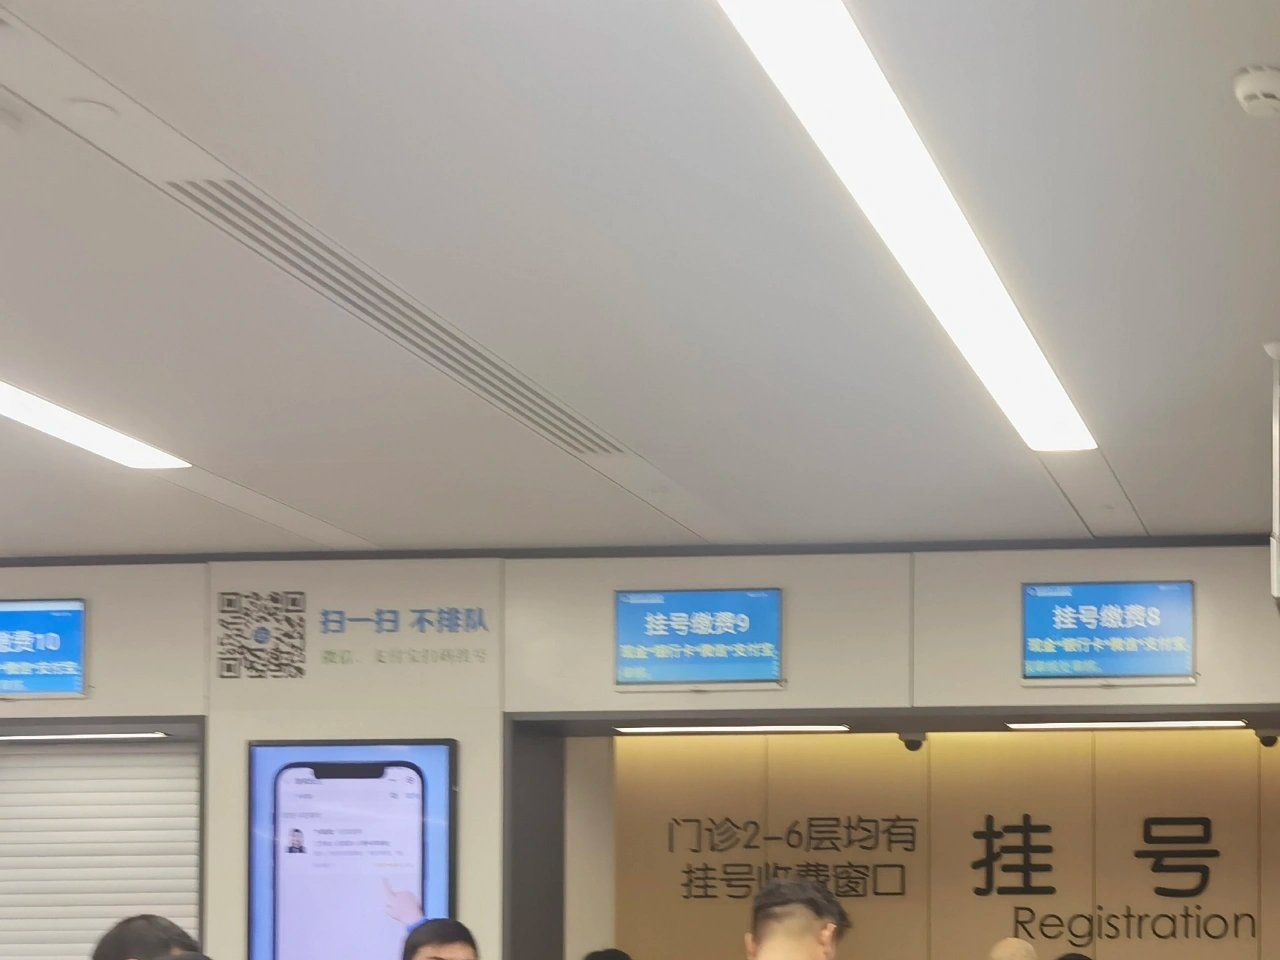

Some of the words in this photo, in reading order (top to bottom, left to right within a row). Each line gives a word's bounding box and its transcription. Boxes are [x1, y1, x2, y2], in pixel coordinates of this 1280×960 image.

[320, 609, 400, 634] 扫一扫
[409, 606, 490, 633] 不排队
[643, 611, 750, 636] 挂号缴费9
[1052, 604, 1161, 629] 挂号缴费8
[667, 815, 919, 852] 门诊2-6层均有
[1013, 904, 1256, 947] Registration
